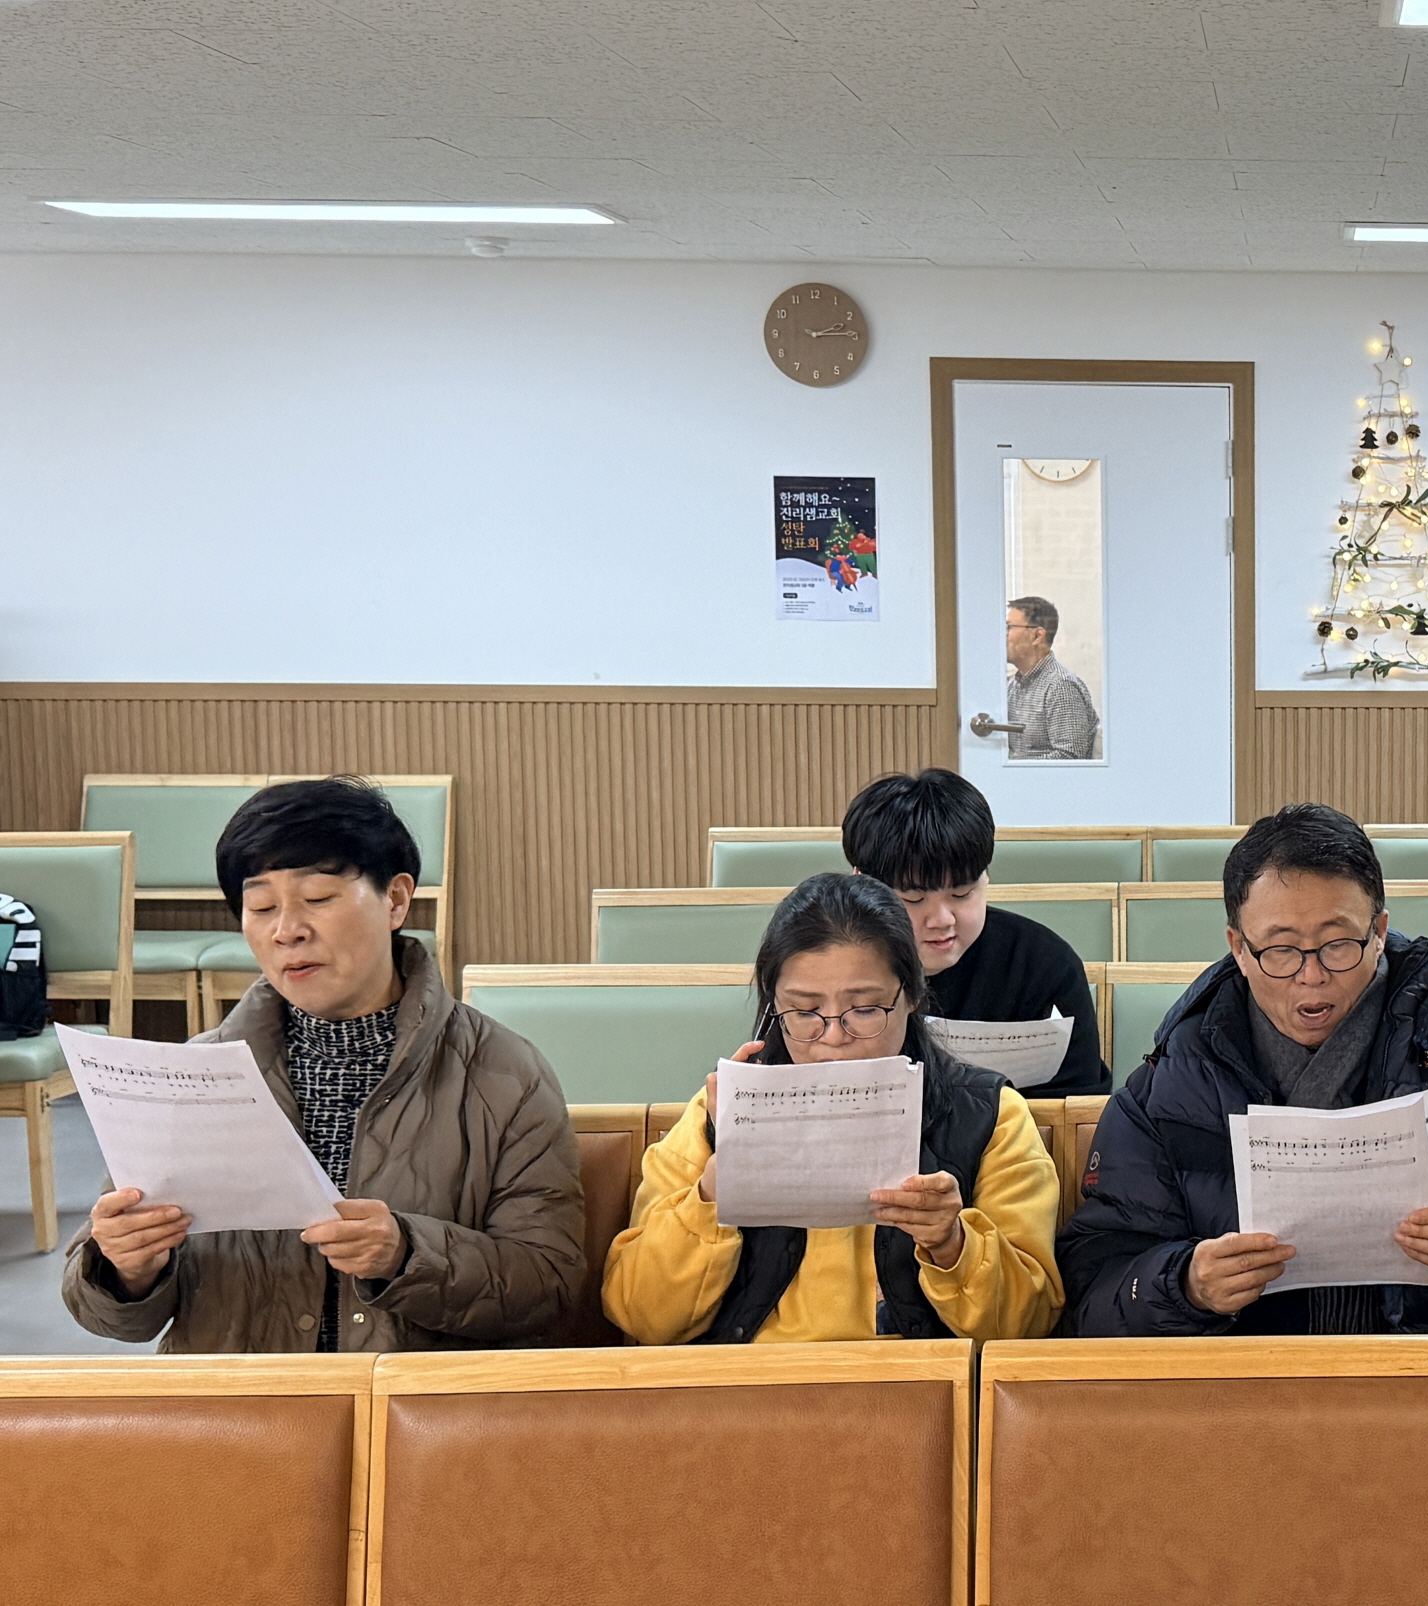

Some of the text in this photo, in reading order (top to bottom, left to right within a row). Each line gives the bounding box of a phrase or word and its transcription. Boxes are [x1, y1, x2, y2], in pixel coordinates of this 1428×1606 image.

[810, 290, 820, 299] 12
[792, 295, 800, 304] 11
[777, 309, 787, 319] 10
[847, 312, 853, 320] 2
[772, 329, 779, 338] 9
[778, 348, 784, 358] 8
[847, 352, 854, 360] 4
[794, 362, 800, 371] 7
[834, 366, 840, 374] 5
[813, 370, 820, 379] 6
[780, 492, 840, 506] 함께해요~
[780, 507, 841, 521] 진리샘교회
[781, 522, 805, 535] 성탄
[781, 537, 819, 551] 발표회
